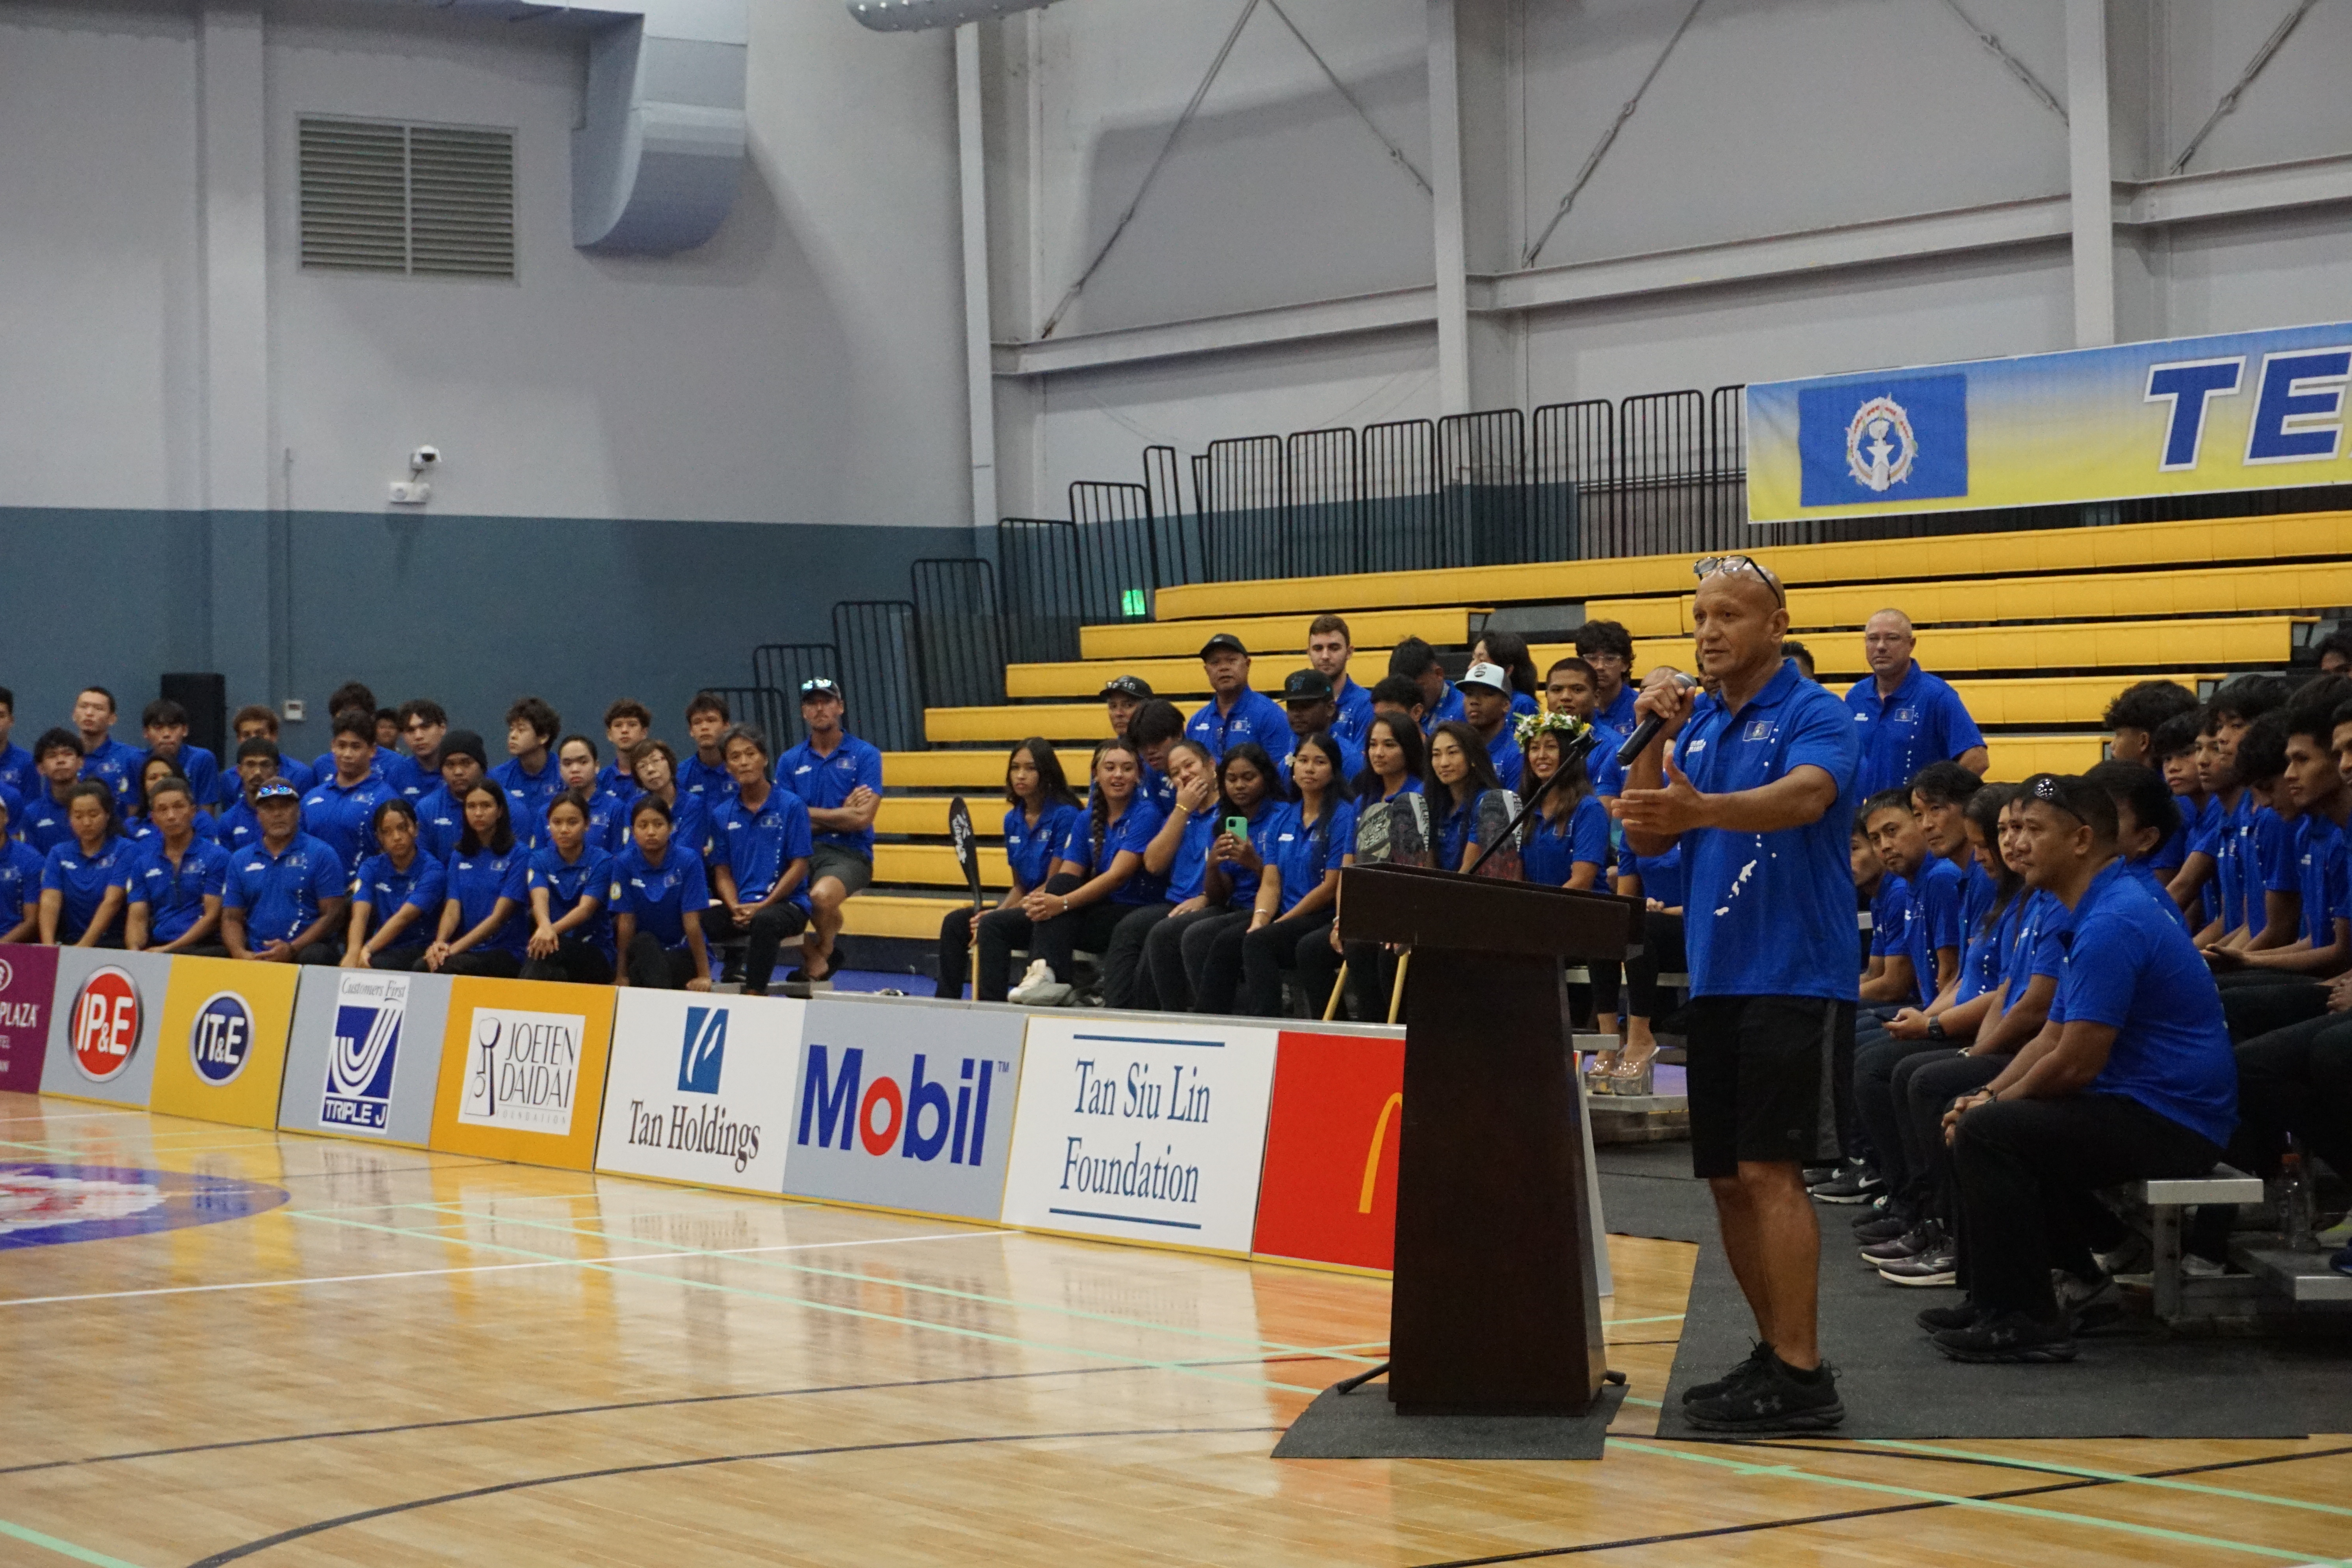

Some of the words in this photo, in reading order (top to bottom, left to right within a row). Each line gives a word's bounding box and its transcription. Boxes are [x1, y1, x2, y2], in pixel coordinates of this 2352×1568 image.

[2144, 345, 2352, 472] TE
[342, 978, 384, 996] Customers
[385, 980, 406, 998] First
[78, 992, 133, 1056] IP&E
[198, 1013, 245, 1064] IT&E
[505, 1022, 578, 1065] JOETEN
[325, 1100, 373, 1125] TRIPLE
[375, 1104, 387, 1126] J
[499, 1062, 572, 1109] DAIDAI
[797, 1044, 994, 1166] Mobil
[1074, 1057, 1116, 1116] Tan
[1123, 1062, 1161, 1120] Siu
[1167, 1065, 1211, 1123] Lin
[496, 1109, 566, 1125] FOUNDATION
[628, 1099, 663, 1147] Tan
[667, 1103, 760, 1173] Holdings
[1060, 1136, 1199, 1203] Foundation
